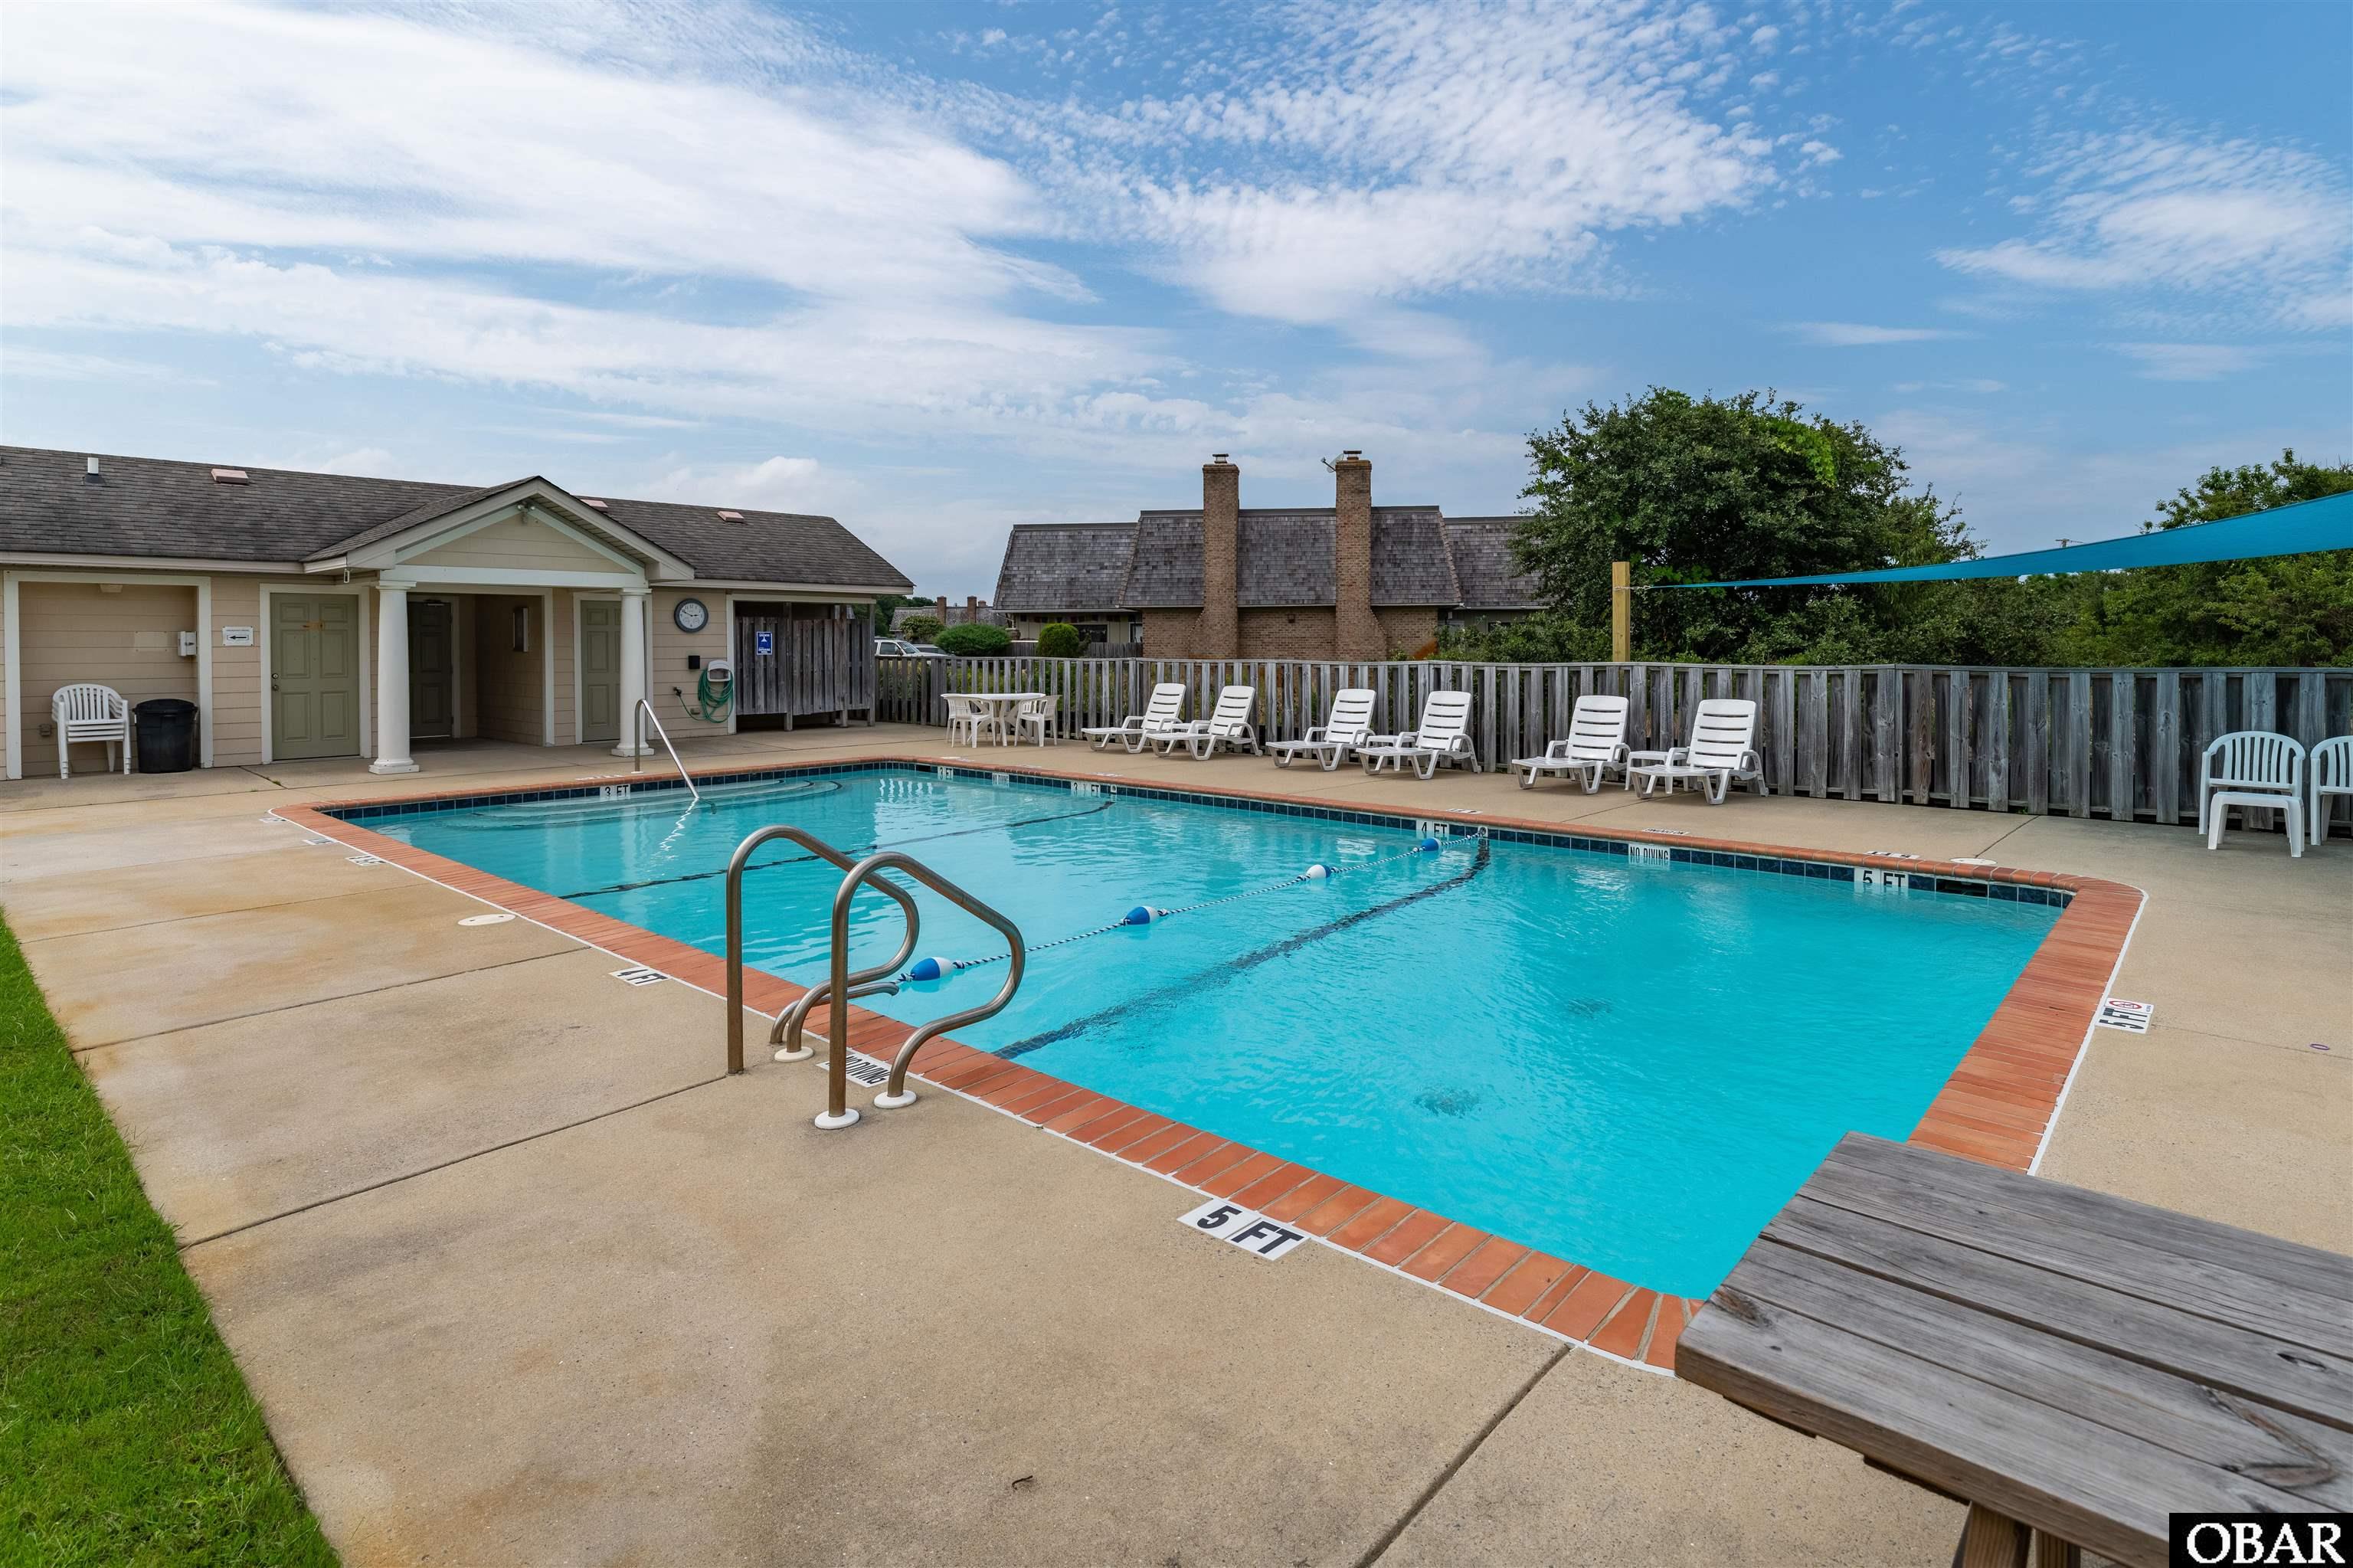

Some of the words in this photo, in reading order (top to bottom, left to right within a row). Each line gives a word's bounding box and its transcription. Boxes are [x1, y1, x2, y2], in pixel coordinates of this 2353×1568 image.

[604, 786, 611, 796] 3
[617, 785, 629, 797] FT
[1091, 784, 1099, 793] FT
[1434, 823, 1447, 833] FT
[1630, 846, 1640, 857] NO
[1644, 848, 1668, 859] DIVING
[1862, 870, 1873, 883] 5
[1883, 872, 1906, 887] FT
[627, 973, 668, 984] FT
[2103, 1007, 2148, 1023] FT
[2099, 1019, 2145, 1030] 5
[1196, 1205, 1242, 1229] 5
[1230, 1221, 1304, 1254] FT
